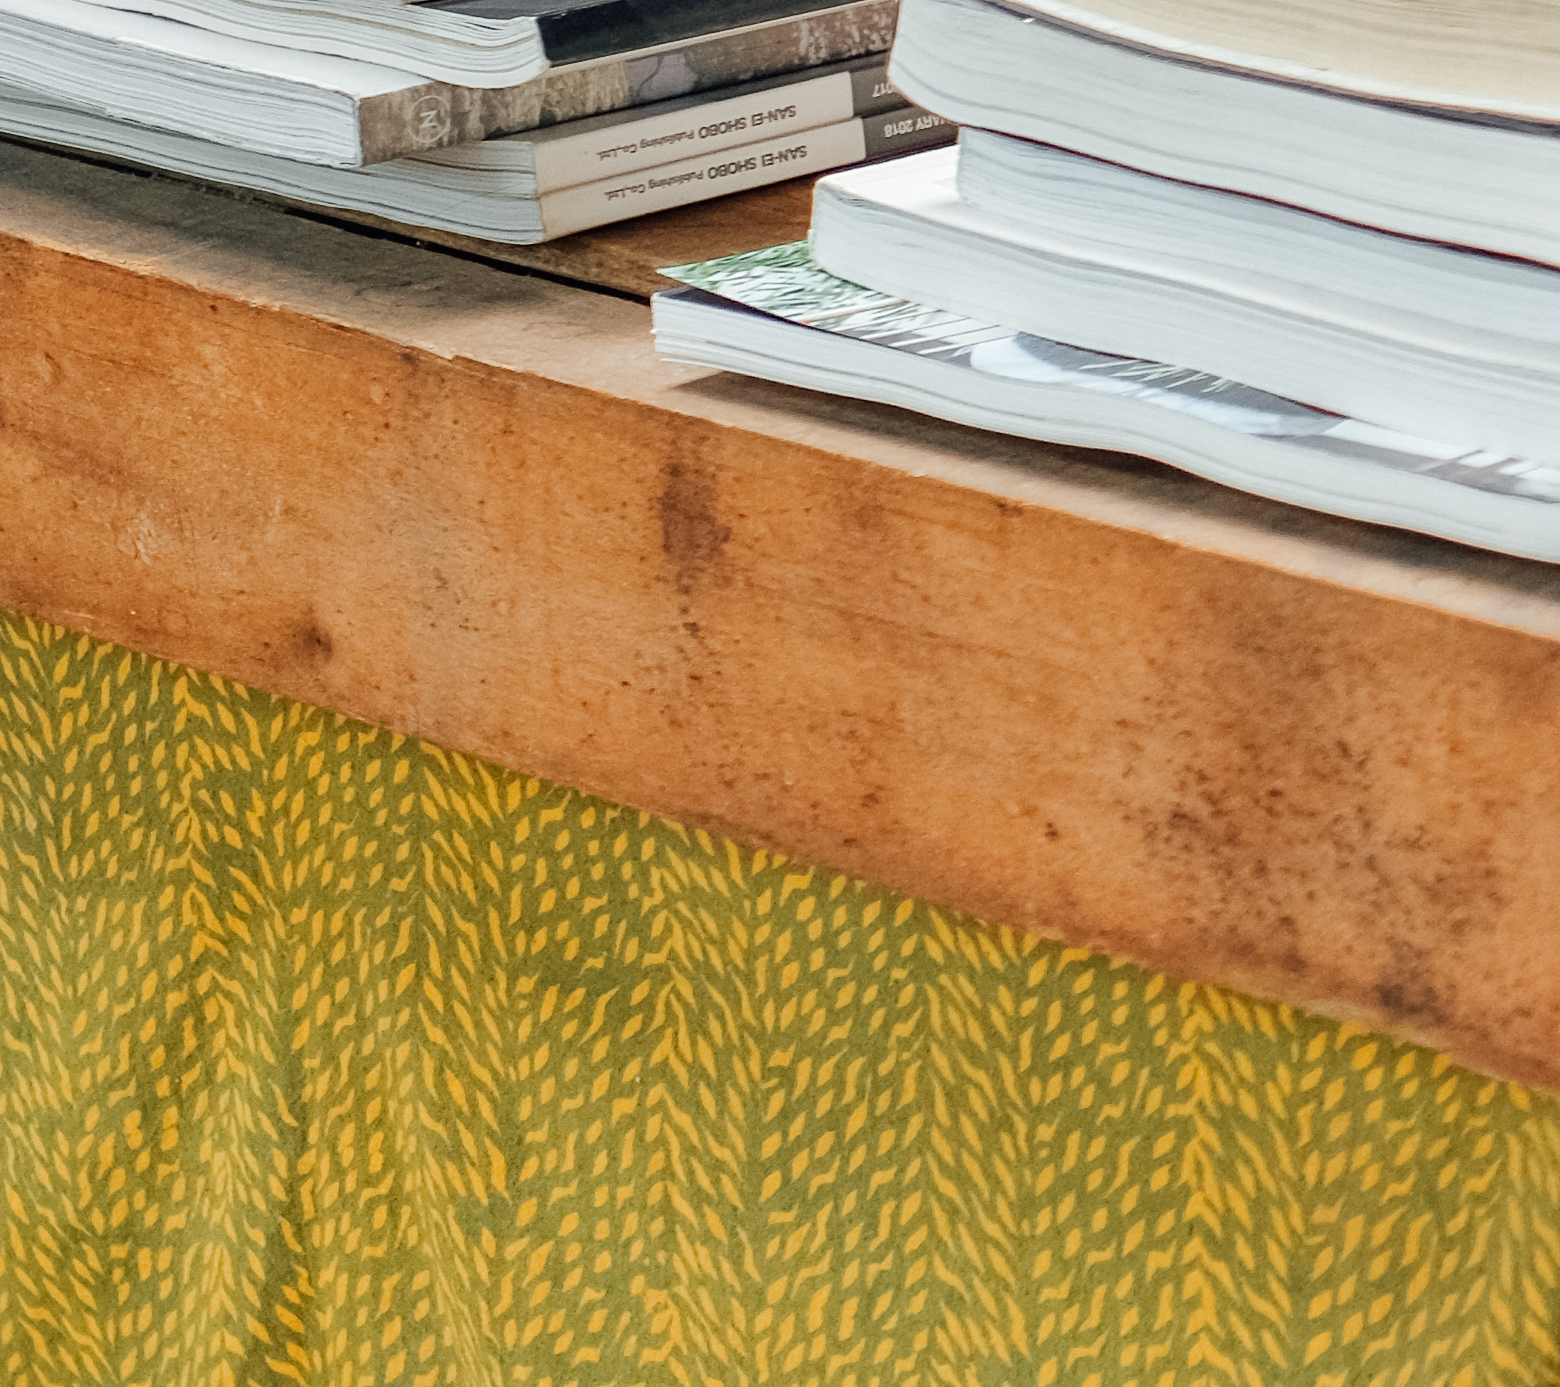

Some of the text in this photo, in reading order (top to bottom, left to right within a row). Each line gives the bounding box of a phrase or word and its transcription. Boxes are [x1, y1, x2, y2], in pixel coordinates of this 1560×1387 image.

[750, 103, 798, 126] SAN-EI
[639, 128, 696, 149] Publishing
[698, 116, 748, 140] SHOBO
[883, 120, 916, 139] 2018
[760, 144, 809, 167] SAN-EI
[647, 169, 705, 189] Publishing
[707, 157, 758, 180] SHOBO
